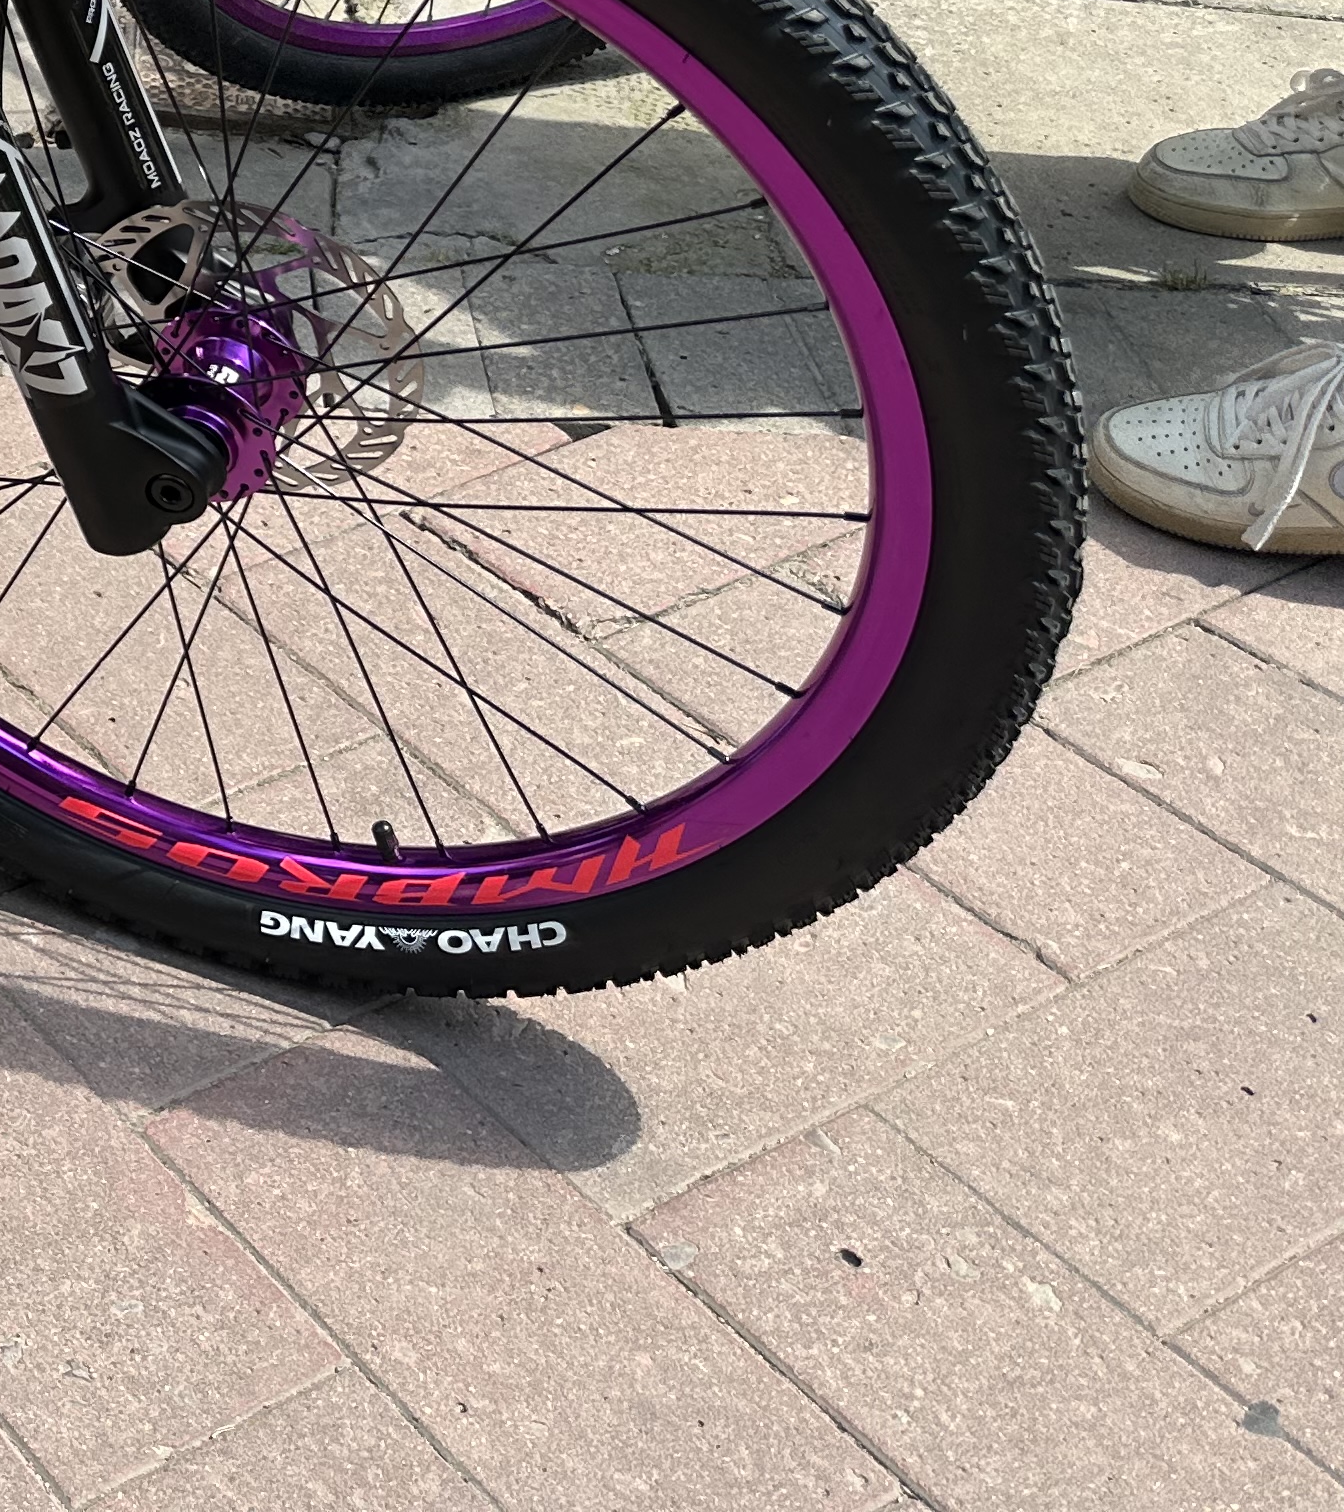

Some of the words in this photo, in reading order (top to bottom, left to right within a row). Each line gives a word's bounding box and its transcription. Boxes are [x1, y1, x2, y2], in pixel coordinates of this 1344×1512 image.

[101, 60, 136, 126] RACING
[127, 125, 162, 190] MOAOZ
[58, 796, 717, 908] HMBROS
[259, 910, 384, 951] YANG
[437, 919, 568, 954] CHAO
